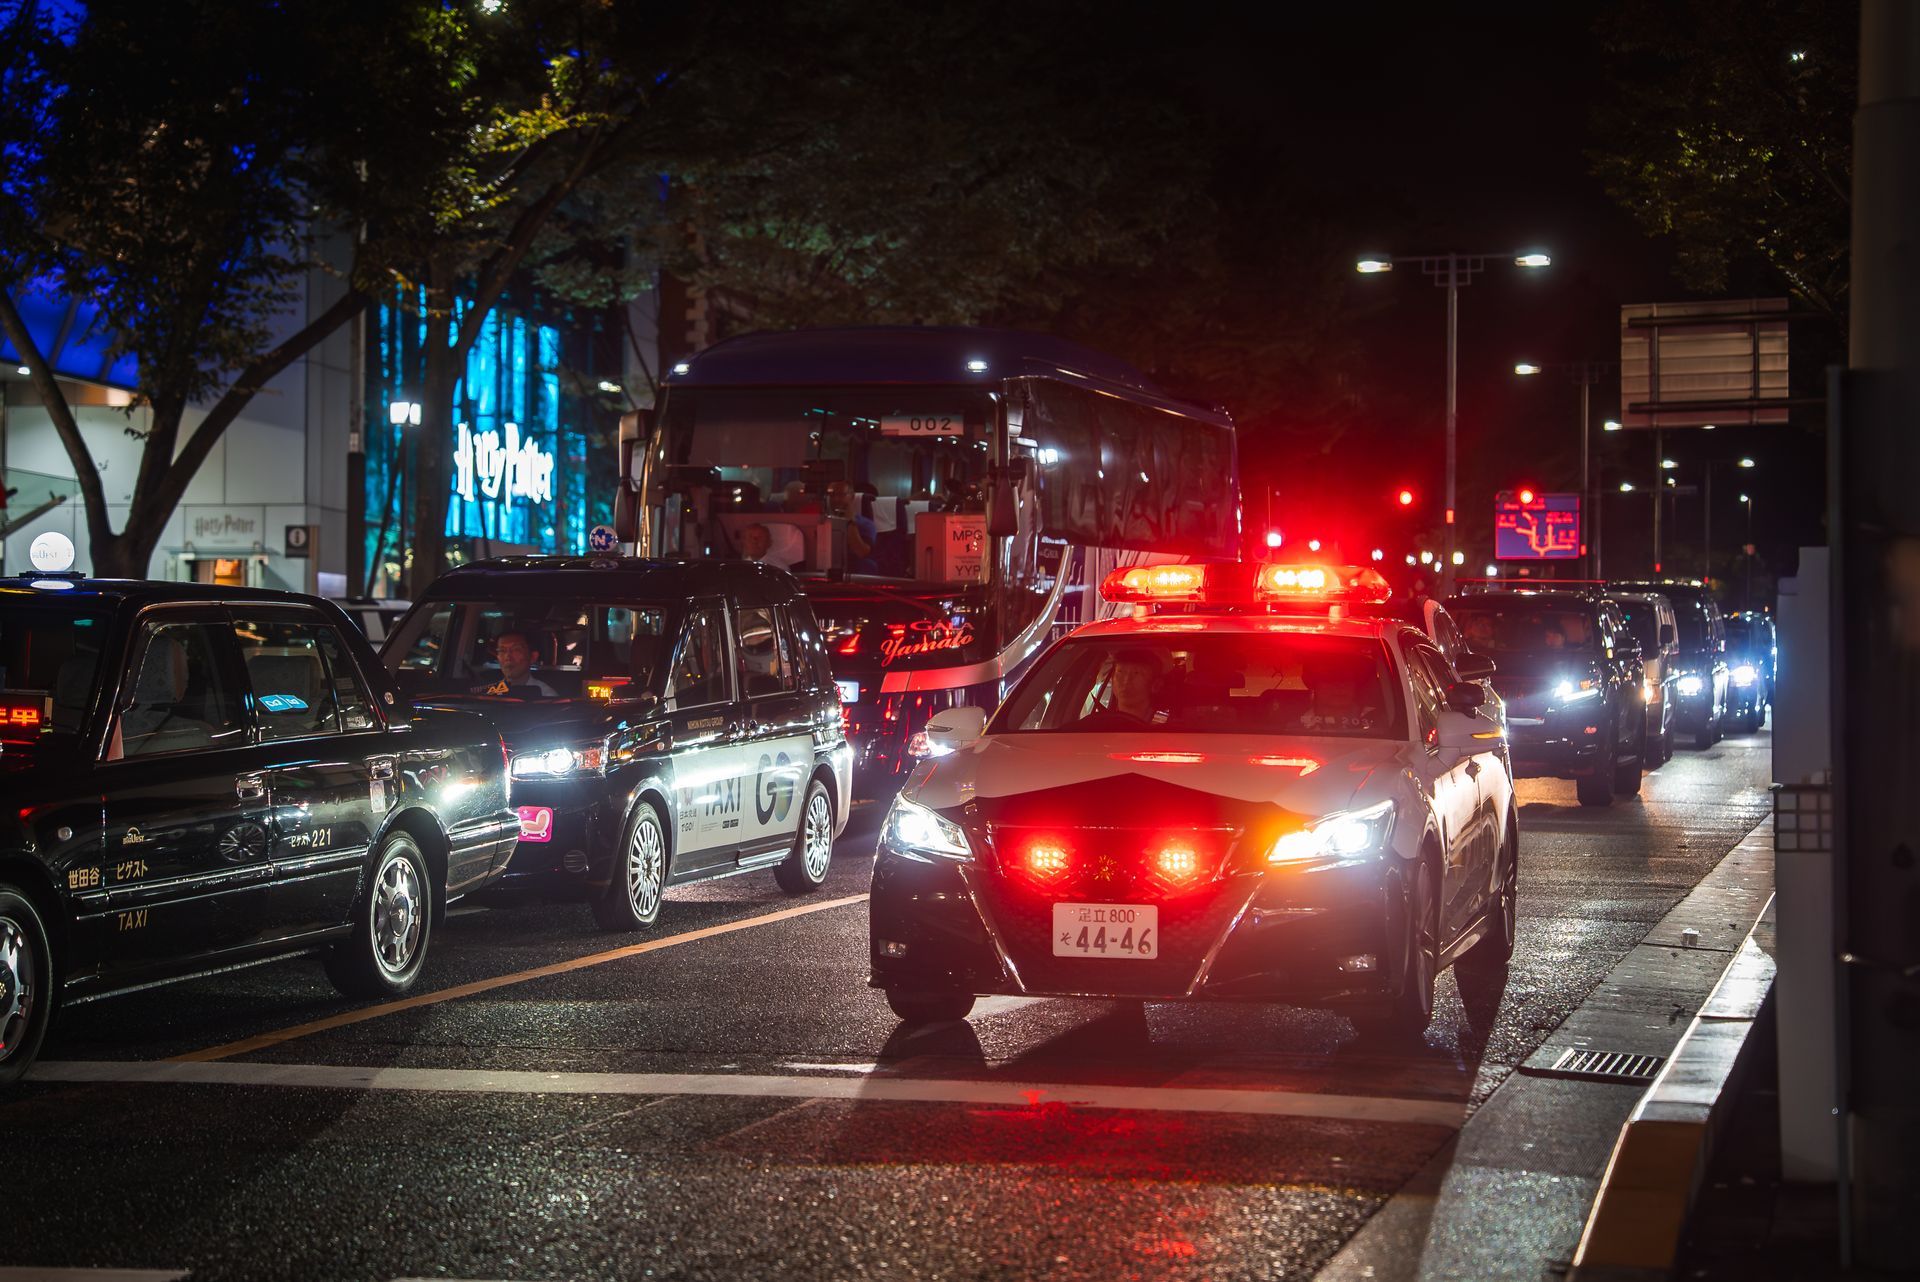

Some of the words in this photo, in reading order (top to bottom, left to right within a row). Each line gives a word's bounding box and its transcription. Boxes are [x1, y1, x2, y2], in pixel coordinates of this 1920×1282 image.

[910, 418, 952, 431] 002
[194, 516, 222, 537] Harry
[952, 530, 983, 541] MPG
[910, 620, 975, 631] GALA
[880, 630, 975, 668] Yamato
[705, 776, 741, 817] TAXI
[756, 751, 794, 826] GO
[312, 828, 331, 848] 221
[68, 867, 100, 889] 世田谷
[118, 909, 148, 932] TAXI
[1078, 907, 1107, 923] 足立
[1109, 909, 1135, 923] 800
[1060, 932, 1072, 946] そ
[1076, 926, 1152, 955] 44-46
